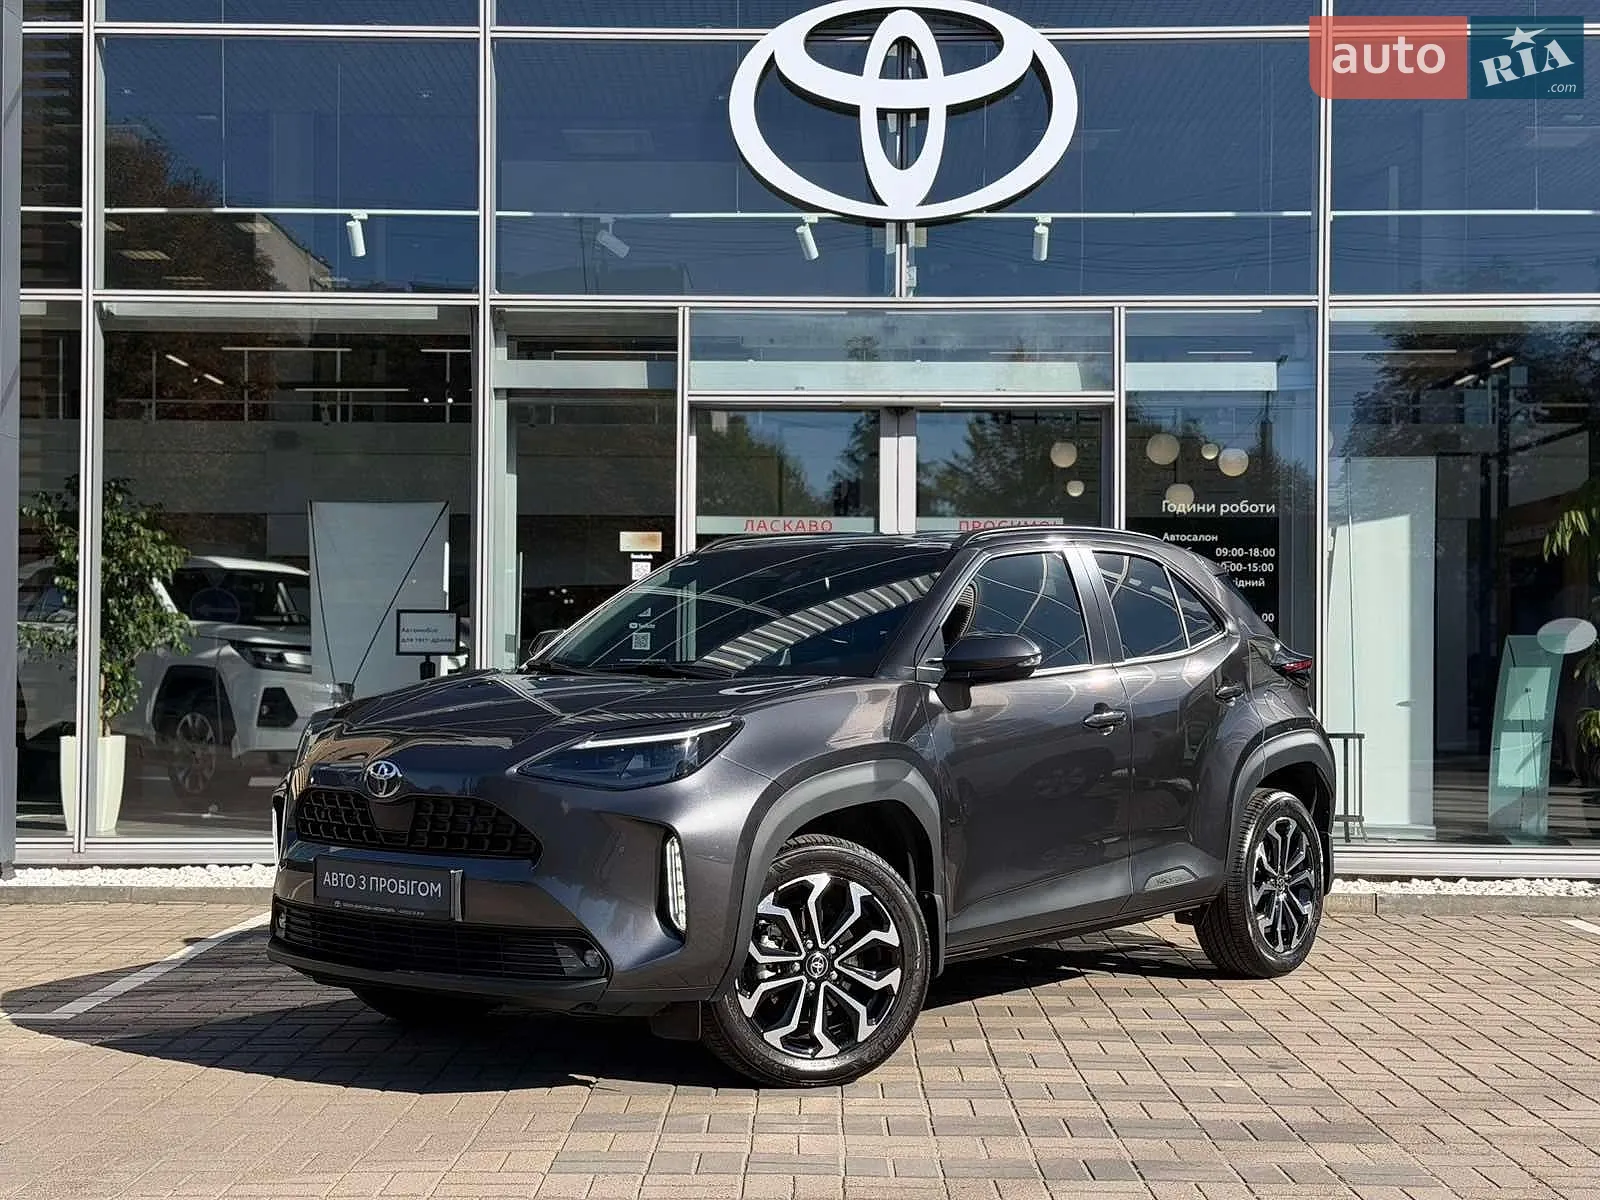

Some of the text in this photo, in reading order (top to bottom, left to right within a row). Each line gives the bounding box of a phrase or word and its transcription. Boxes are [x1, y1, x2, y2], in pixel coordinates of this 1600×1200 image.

[1162, 500, 1276, 516] Години роботи
[743, 519, 833, 532] ЛАСКАВО
[1162, 532, 1218, 542] Автосалон
[1215, 547, 1275, 557] 09:00-18:00
[1217, 562, 1274, 572] 0:00-15:00
[1233, 577, 1265, 588] ідний
[323, 871, 442, 897] АВТО З ПРОБІГОМ
